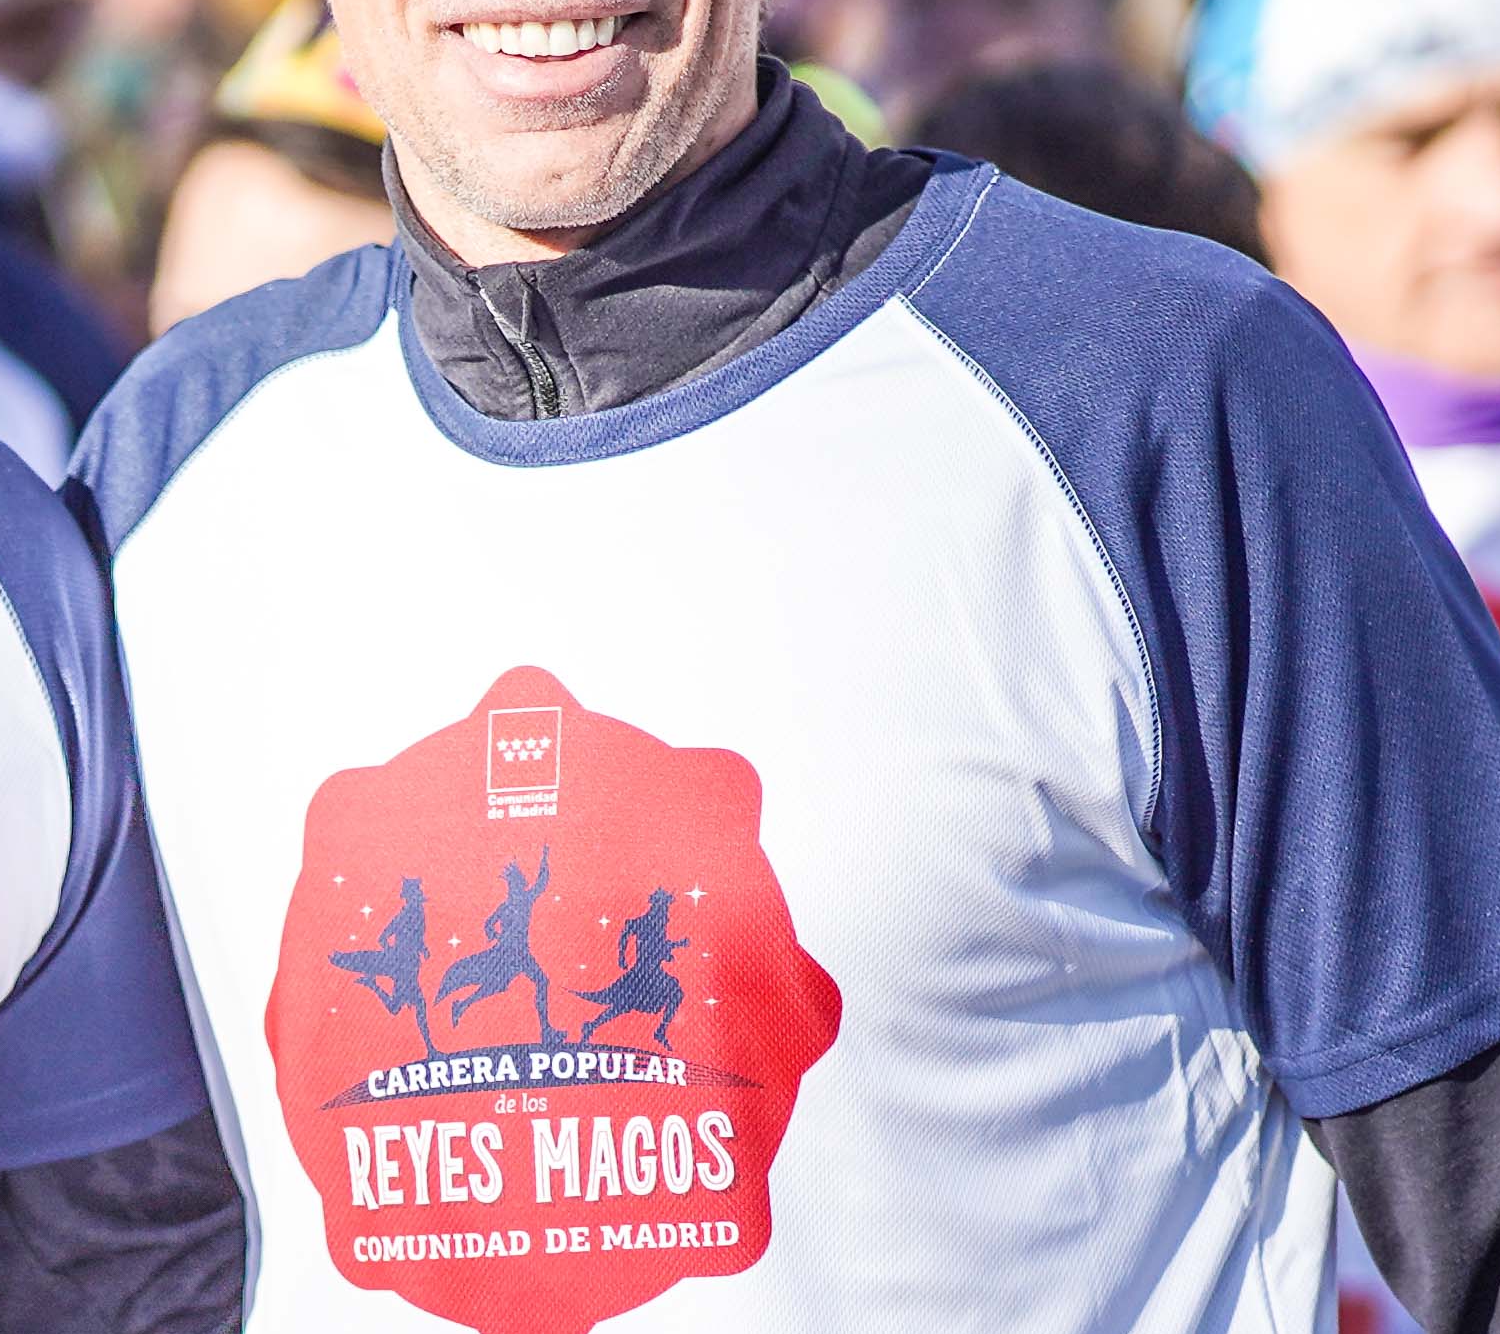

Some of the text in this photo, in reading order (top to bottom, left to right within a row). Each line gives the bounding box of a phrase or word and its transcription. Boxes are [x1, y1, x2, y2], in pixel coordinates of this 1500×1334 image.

[487, 790, 558, 806] Comunidad
[487, 802, 557, 819] de Madrid
[367, 1053, 687, 1099] CARRERA POPULAR
[494, 1093, 548, 1114] de los
[343, 1109, 735, 1211] REYES MAGOS
[353, 1220, 739, 1263] COMUNIDAD DE MADRID
